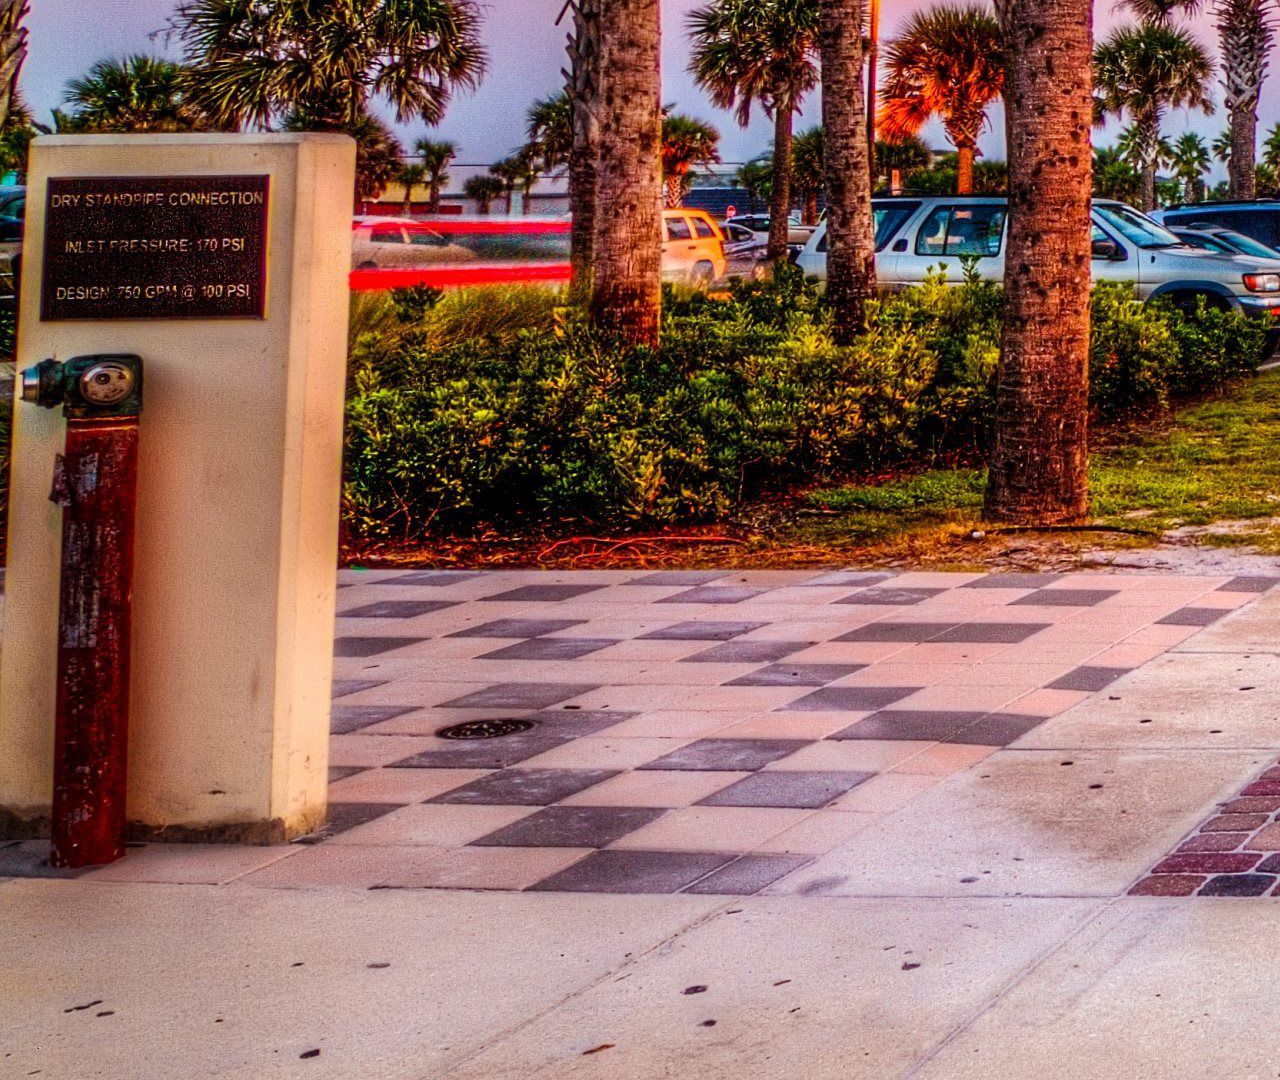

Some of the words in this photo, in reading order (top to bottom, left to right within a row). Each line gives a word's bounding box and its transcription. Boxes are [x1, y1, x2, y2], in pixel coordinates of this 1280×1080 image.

[51, 194, 80, 208] DRY
[85, 193, 164, 207] STANDPIPE
[169, 191, 264, 206] CONNECTION
[65, 241, 104, 254] INLET
[197, 239, 218, 252] 170
[222, 238, 245, 251] PSI
